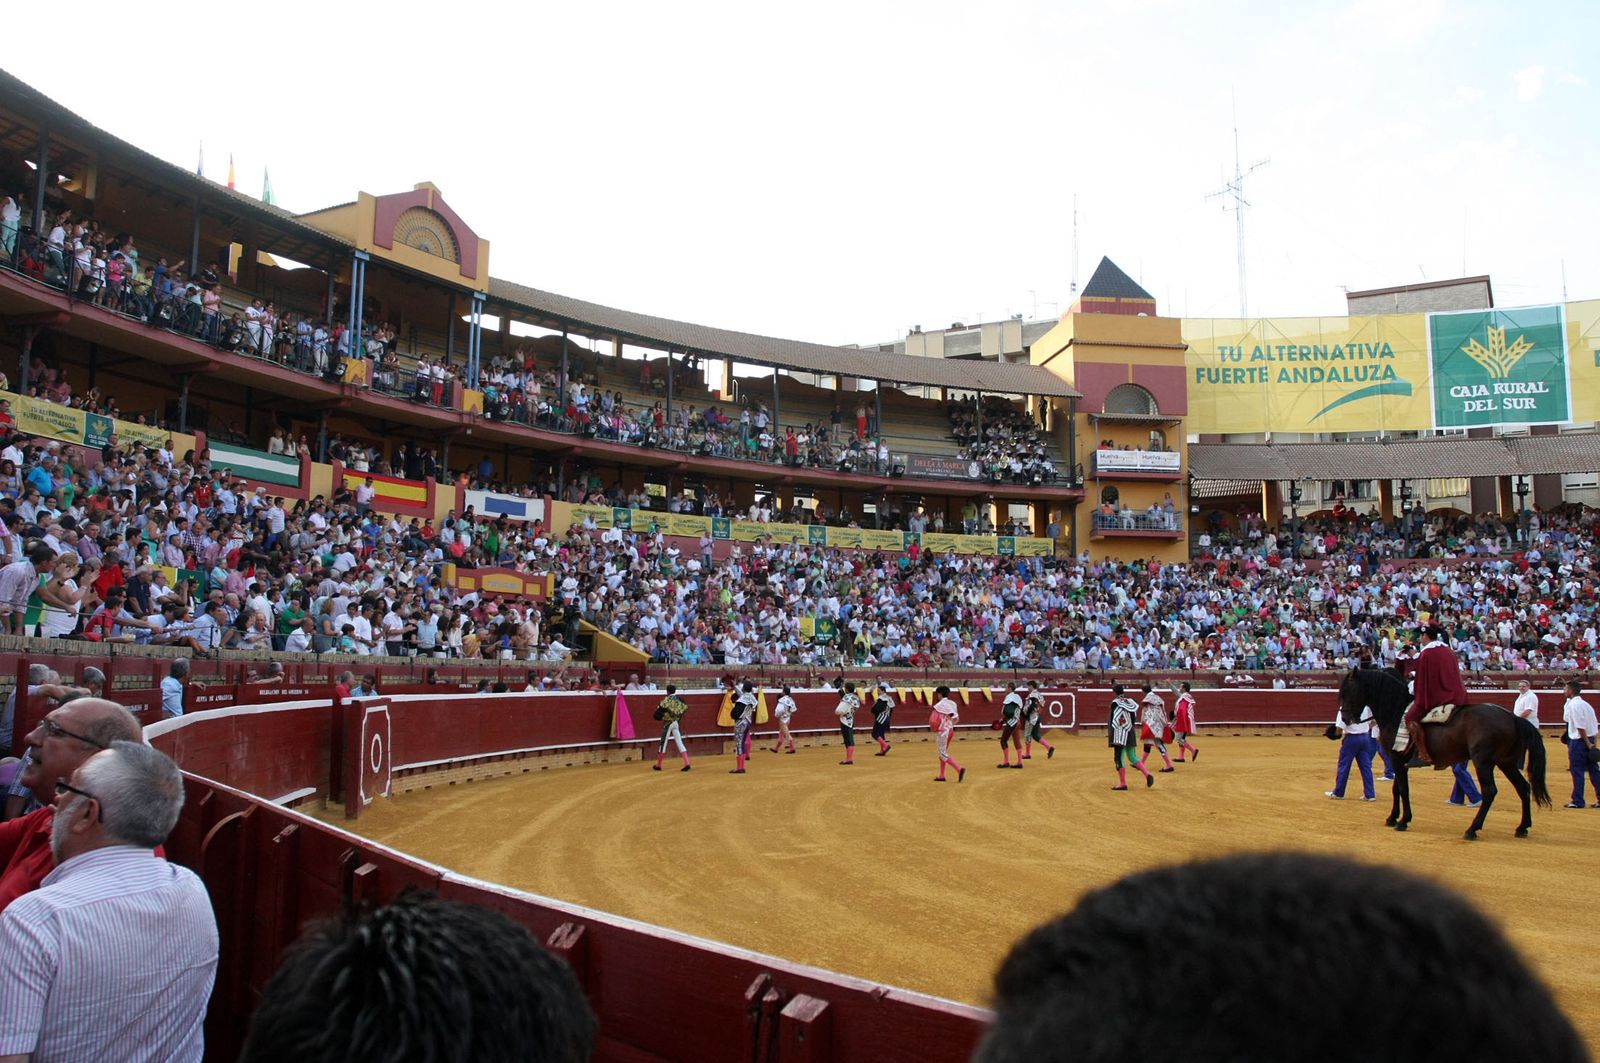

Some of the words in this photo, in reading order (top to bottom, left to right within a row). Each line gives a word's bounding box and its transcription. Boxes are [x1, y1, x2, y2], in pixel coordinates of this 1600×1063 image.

[1217, 345, 1242, 362] TU
[1250, 342, 1395, 362] ALTERNATIVA
[1196, 366, 1268, 384] FUERTE
[1277, 364, 1397, 384] ANDALUZA
[1450, 385, 1490, 398] CAJA
[1493, 381, 1549, 395] RURAL
[1464, 399, 1498, 412] DEL
[1502, 397, 1537, 410] SUR
